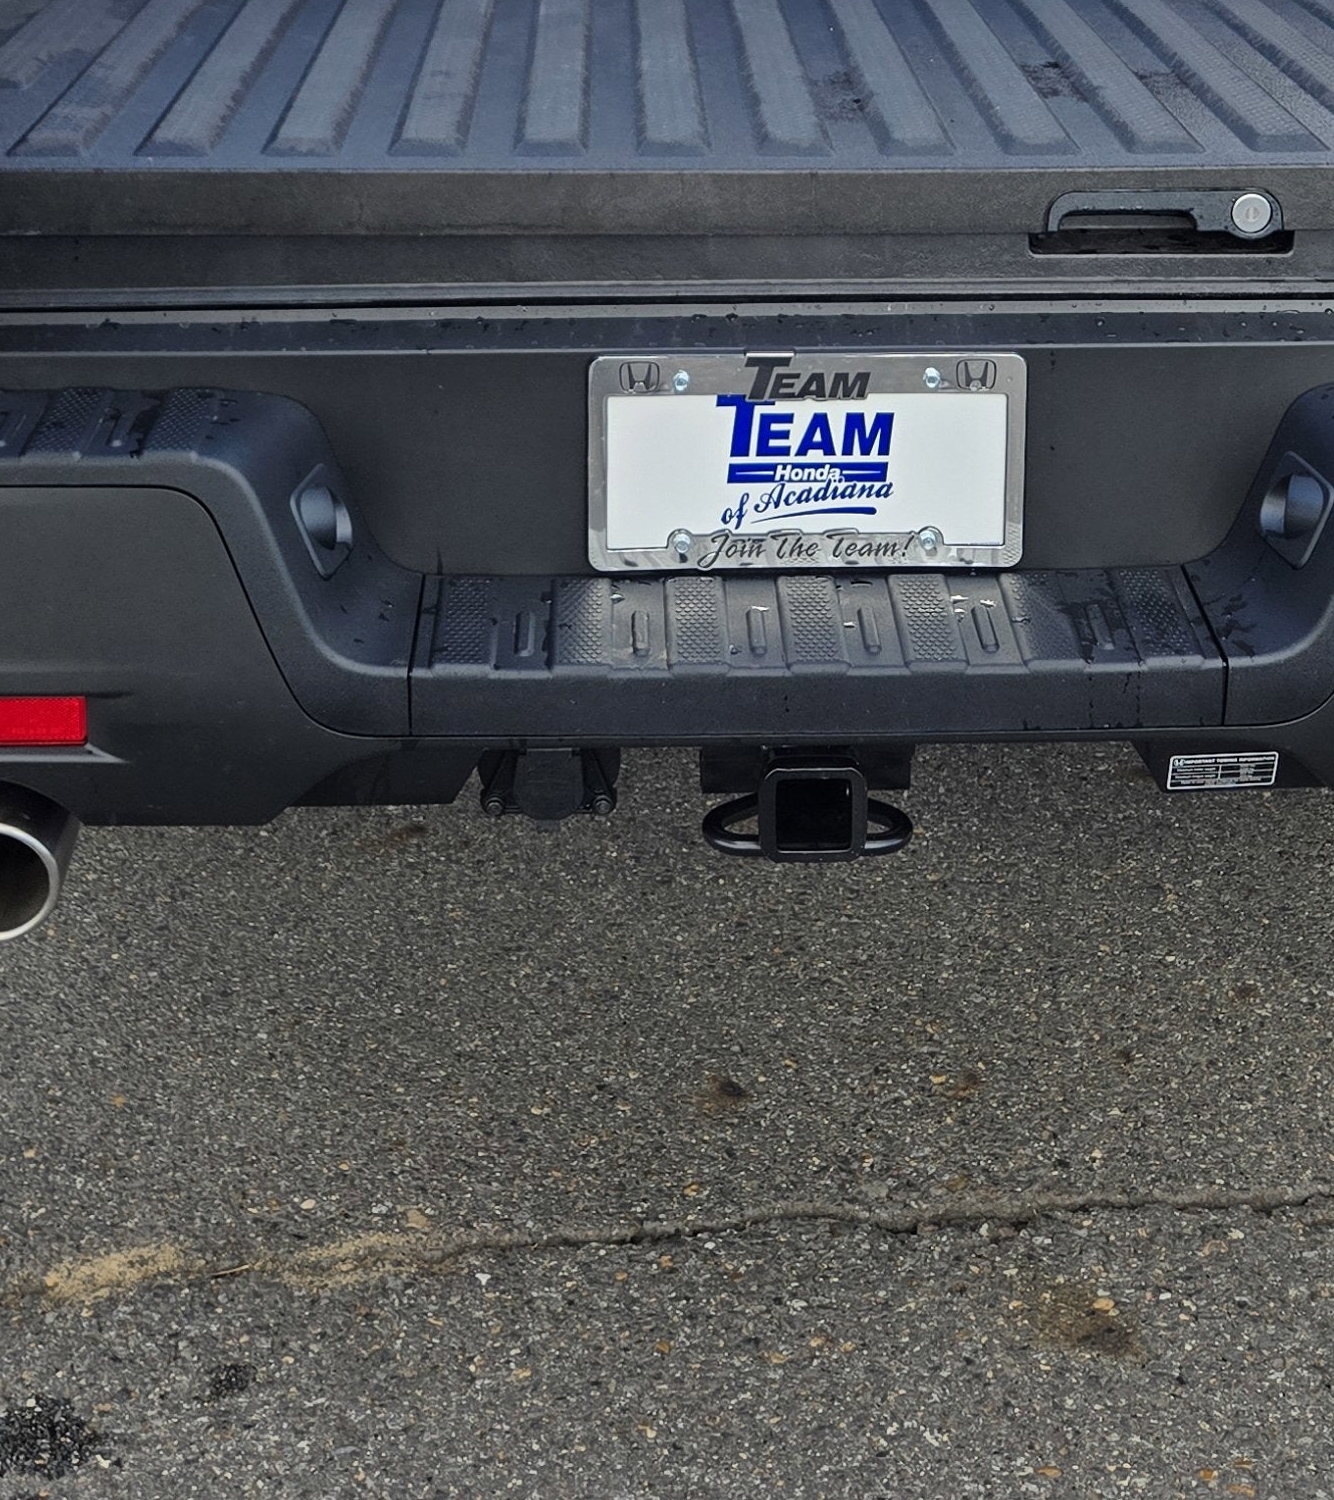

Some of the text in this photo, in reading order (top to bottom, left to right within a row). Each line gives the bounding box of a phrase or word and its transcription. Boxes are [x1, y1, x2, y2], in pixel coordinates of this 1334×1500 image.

[743, 356, 872, 401] TEAM
[715, 394, 895, 458] TEAM
[774, 463, 842, 481] Honda
[720, 476, 894, 530] of Acadiana
[696, 530, 915, 569] Join The Team!
